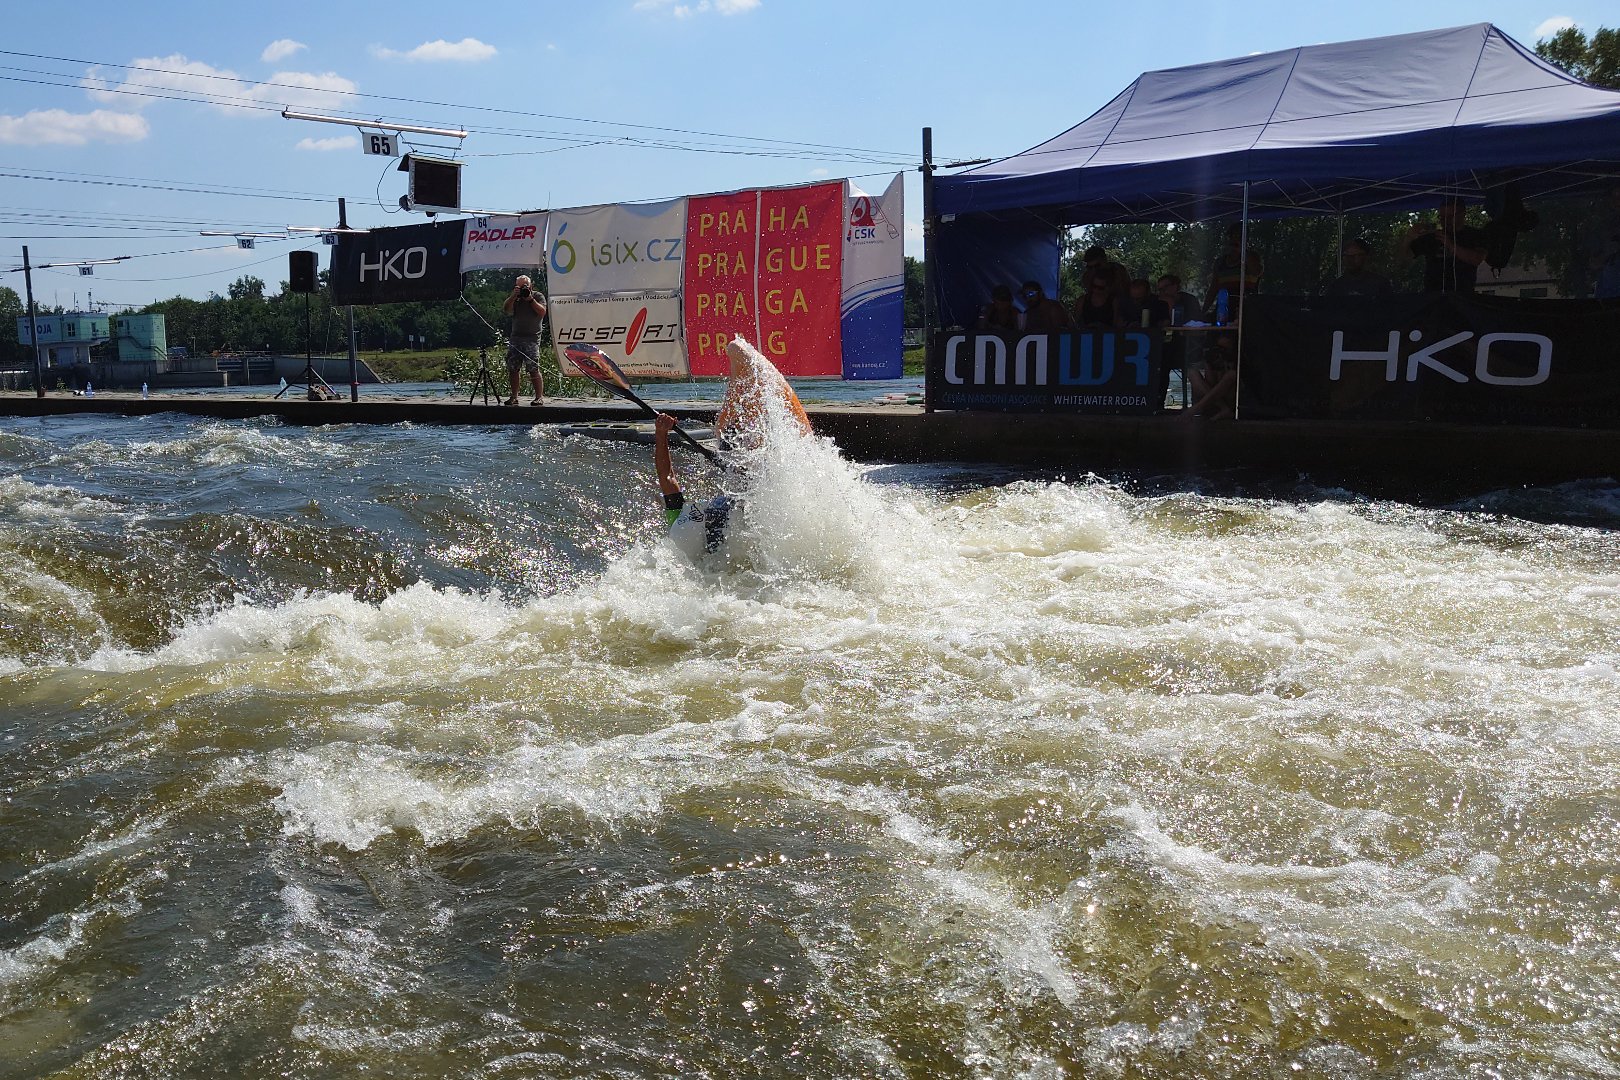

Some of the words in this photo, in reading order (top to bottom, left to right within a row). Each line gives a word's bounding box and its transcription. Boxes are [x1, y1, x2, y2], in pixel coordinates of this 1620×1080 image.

[370, 136, 391, 155] 65
[478, 218, 487, 228] 64
[699, 209, 748, 238] PRA
[769, 205, 809, 232] HA
[241, 239, 251, 249] 62
[325, 235, 335, 244] 63
[698, 251, 748, 277] PRA
[765, 244, 831, 273] GUE
[82, 267, 91, 275] 61
[697, 291, 748, 317] PRA
[765, 288, 809, 315] GA
[24, 324, 52, 335] TOJA
[1054, 394, 1113, 406] WHITEWATER
[1115, 395, 1147, 406] RODEA
